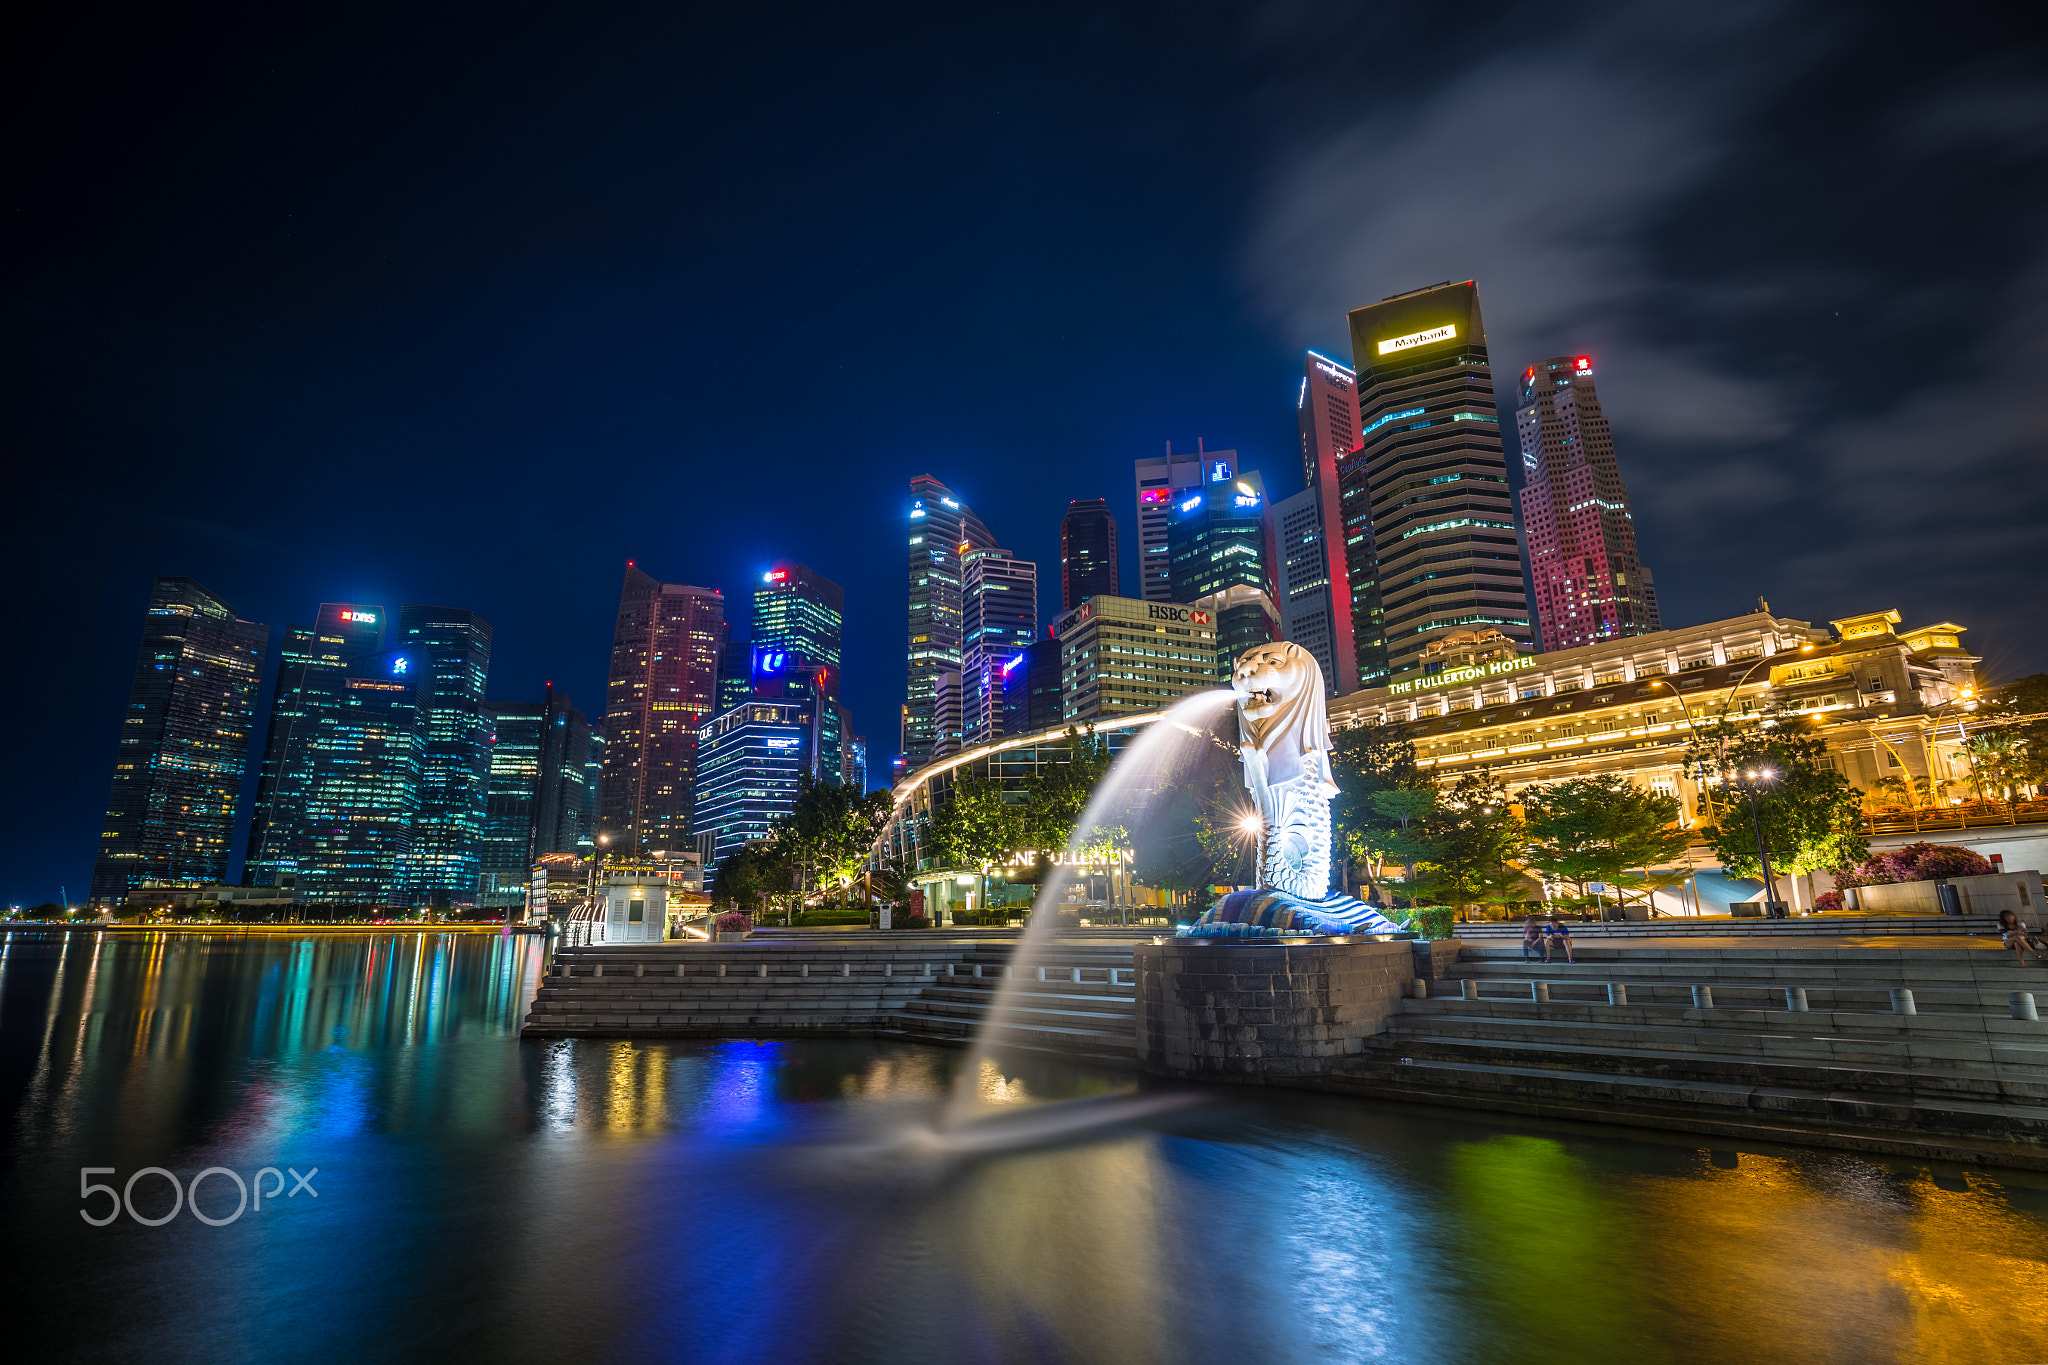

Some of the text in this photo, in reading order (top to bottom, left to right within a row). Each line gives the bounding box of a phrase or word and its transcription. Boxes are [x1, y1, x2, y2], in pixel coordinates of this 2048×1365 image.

[1395, 328, 1448, 348] Maybank
[1576, 369, 1593, 377] UOB
[352, 611, 376, 624] DBS
[1148, 604, 1189, 623] HSBC
[1388, 655, 1537, 695] THE FULLERTON HOTEL
